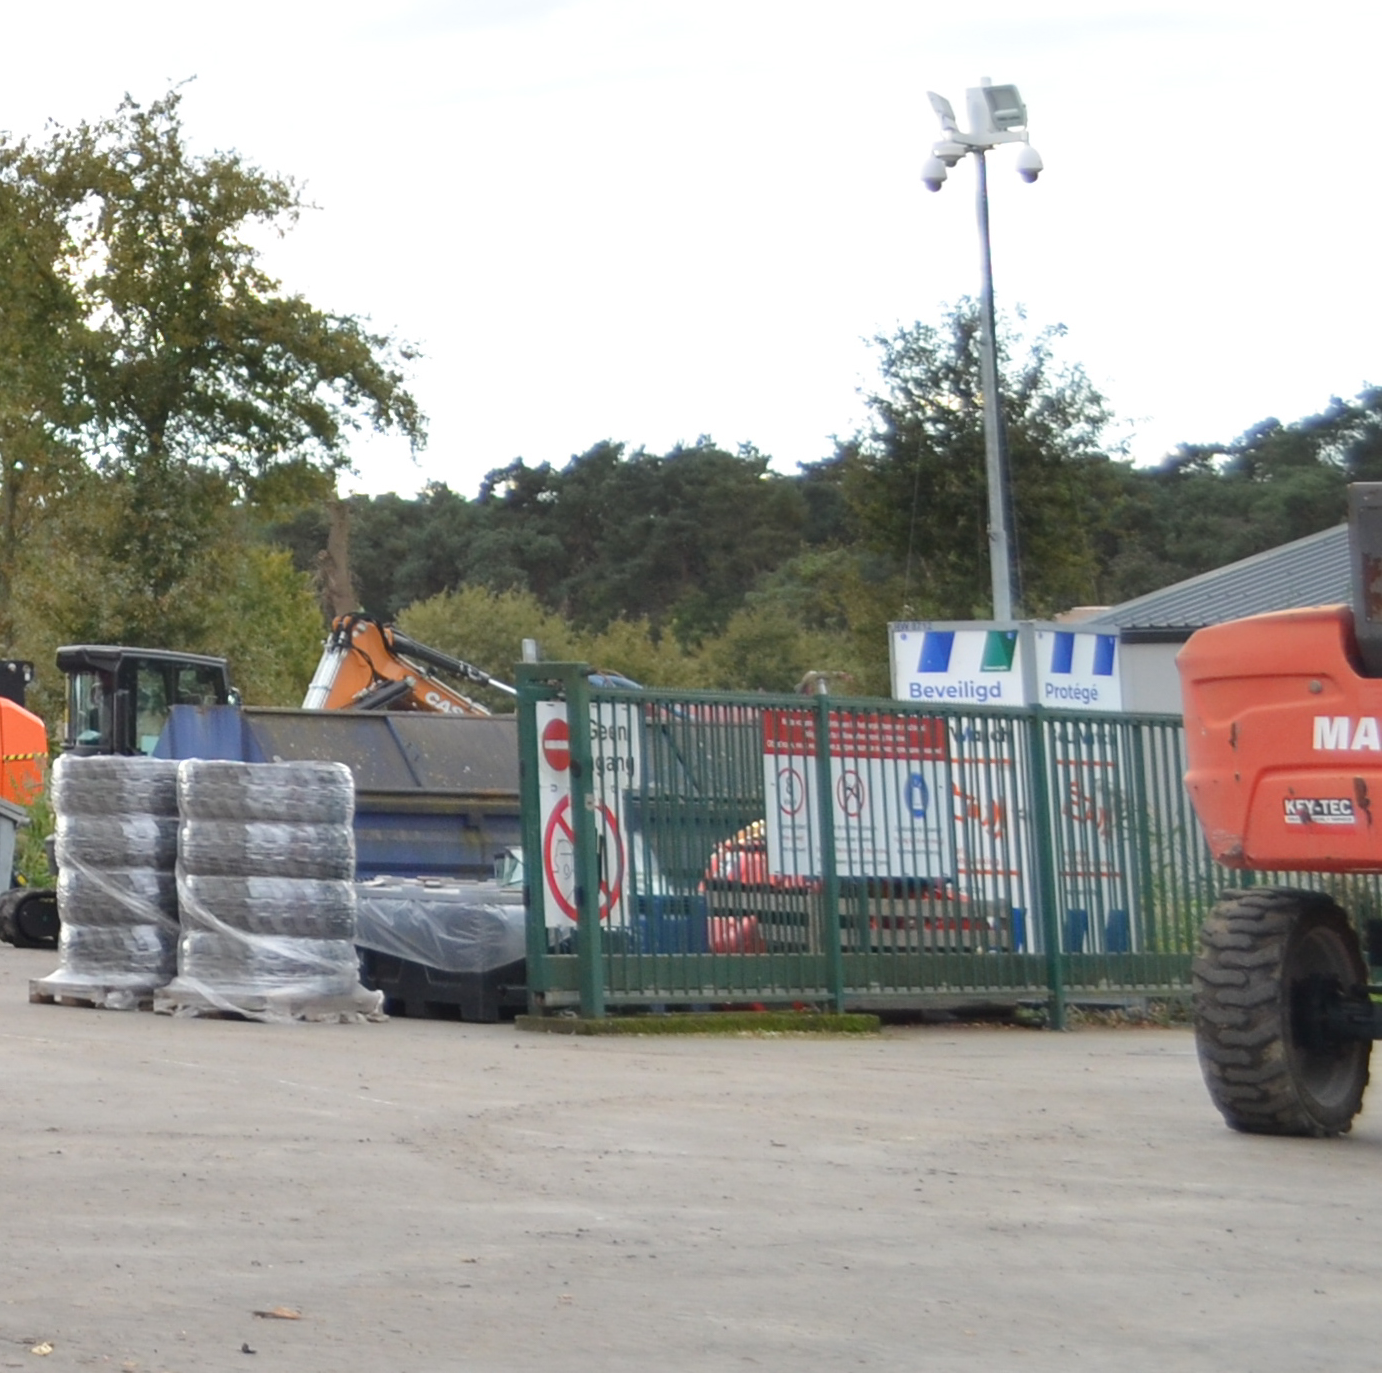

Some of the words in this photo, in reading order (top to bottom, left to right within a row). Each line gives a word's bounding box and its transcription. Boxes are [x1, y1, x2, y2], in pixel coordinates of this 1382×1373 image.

[909, 681, 1002, 702] Beveiligd
[1044, 682, 1099, 704] Protégé
[1313, 715, 1382, 751] MA
